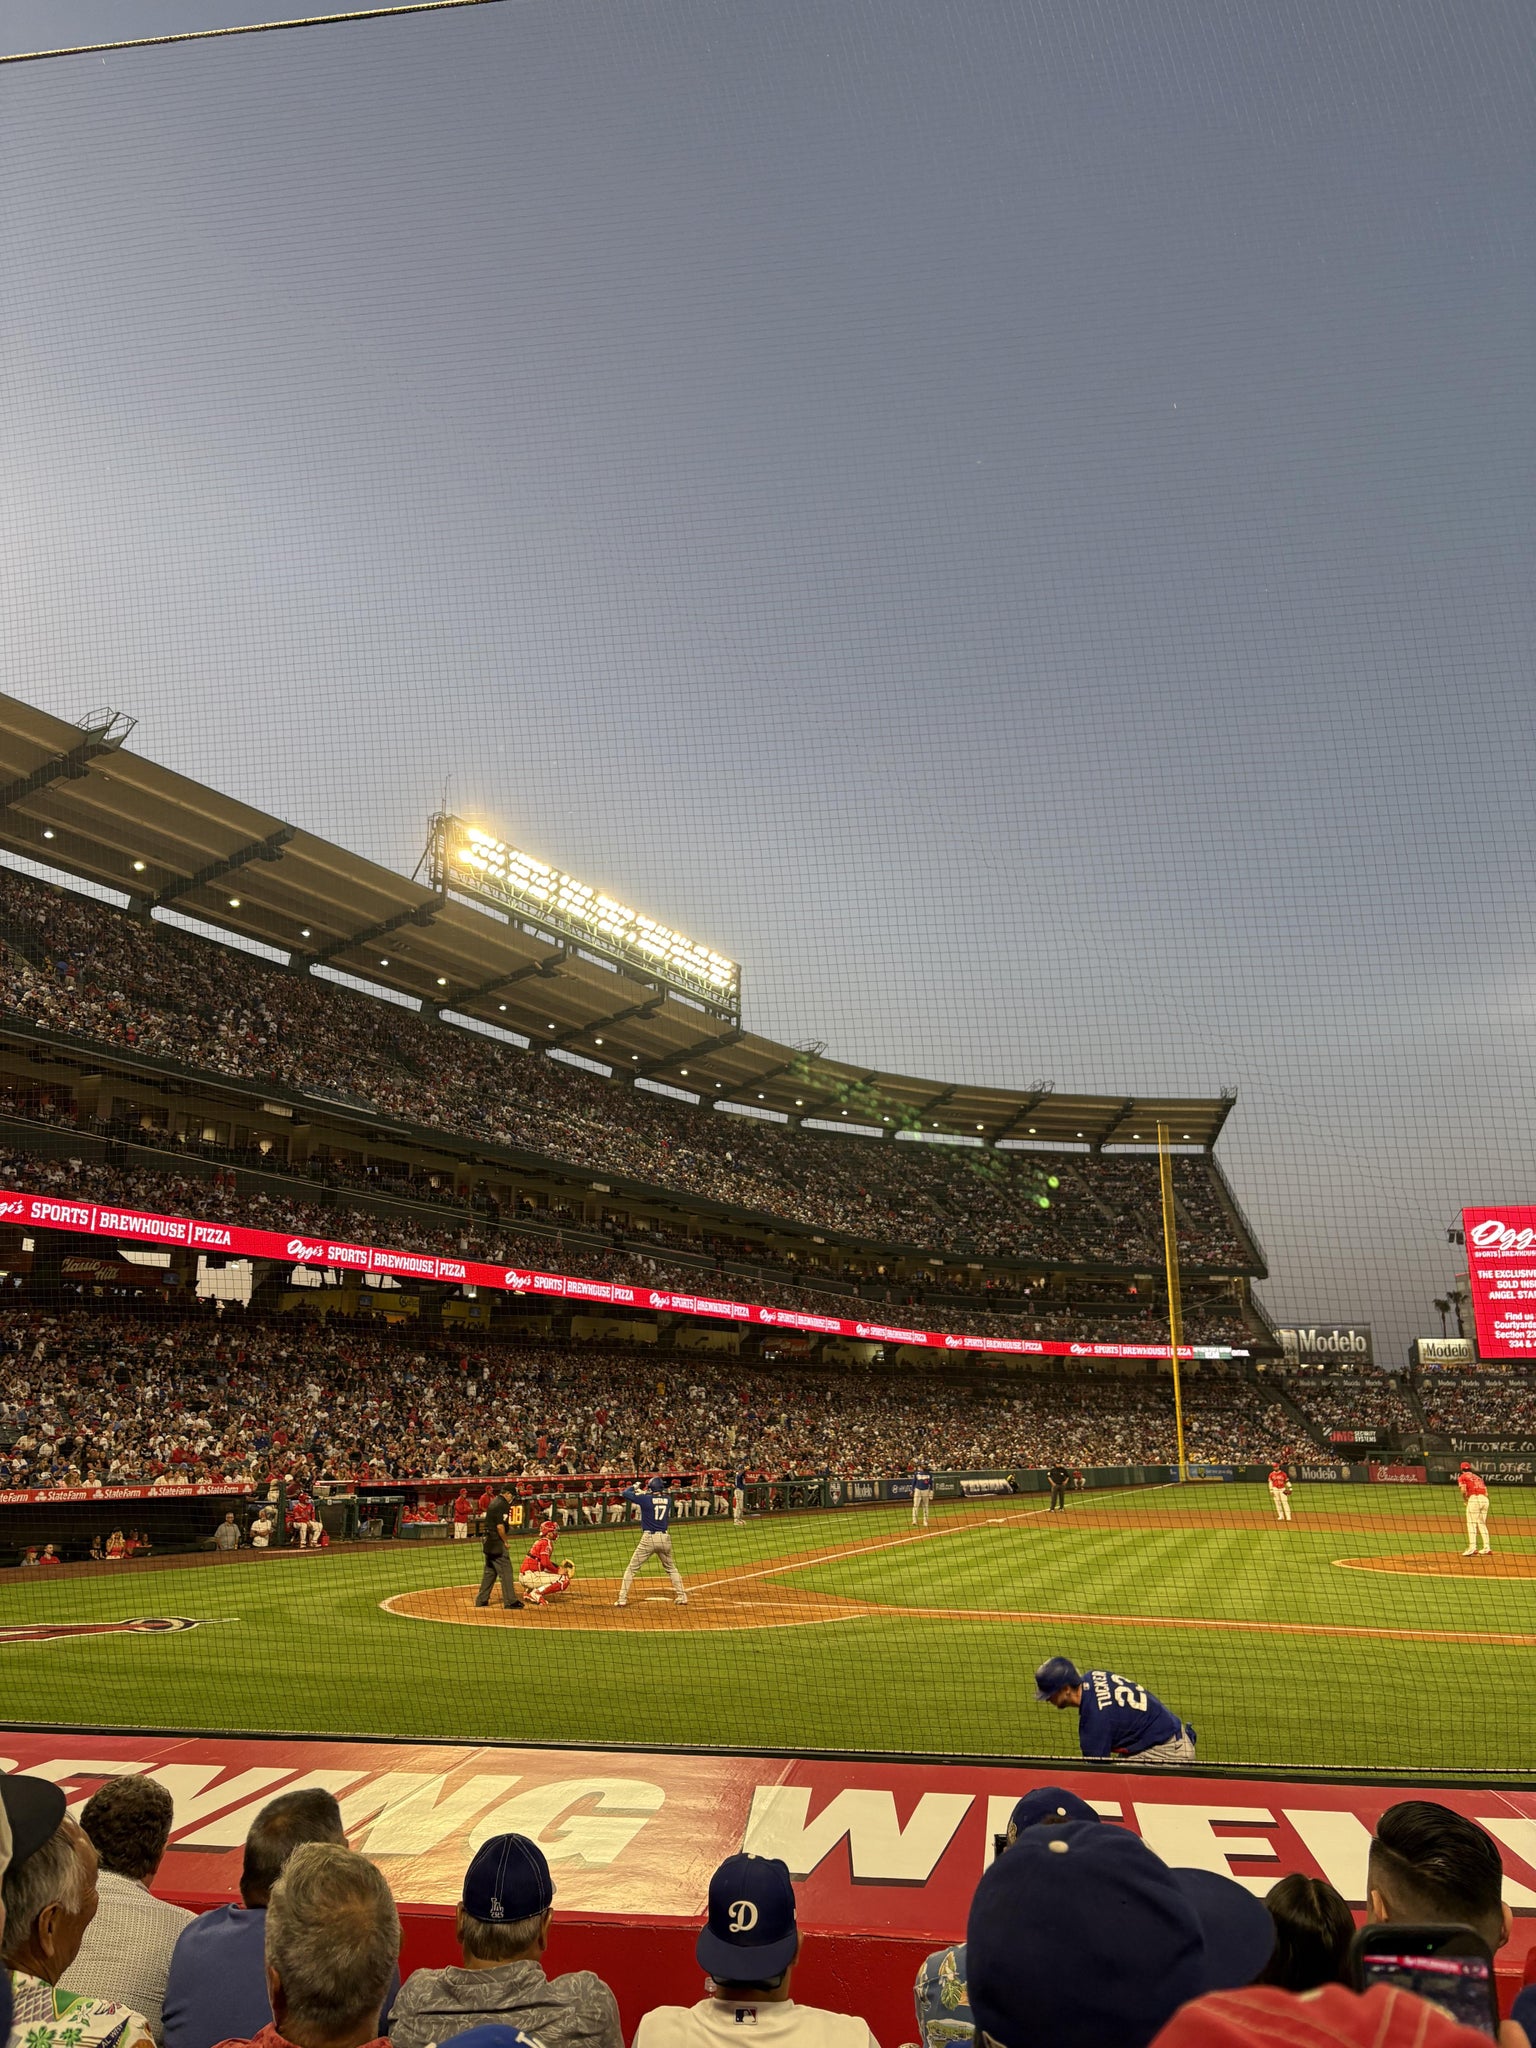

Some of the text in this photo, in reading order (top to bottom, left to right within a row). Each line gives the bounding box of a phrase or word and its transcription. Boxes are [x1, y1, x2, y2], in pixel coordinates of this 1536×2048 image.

[31, 1202, 89, 1225] SPORTS
[99, 1212, 186, 1239] BREWHOUSE
[194, 1226, 231, 1246] PIZZA
[287, 1239, 466, 1278] Oggi's SPORTS BREWHOUSE PIZZA
[1477, 1270, 1494, 1279] THE
[534, 1276, 562, 1291] SPORTS
[567, 1281, 611, 1298] BREWHOUSE
[614, 1288, 634, 1301] PIZZA
[1497, 1280, 1518, 1289] SOLD
[1489, 1291, 1516, 1300] ANGEL
[1505, 1312, 1522, 1321] Find
[1298, 1329, 1367, 1353] Modelo
[1094, 1345, 1119, 1354] SPORTS
[1122, 1346, 1166, 1356] BREWHOUSE
[1426, 1343, 1468, 1357] Modelo
[1302, 1467, 1337, 1480] Modelo
[654, 1505, 667, 1520] 17
[728, 1900, 759, 1933] D
